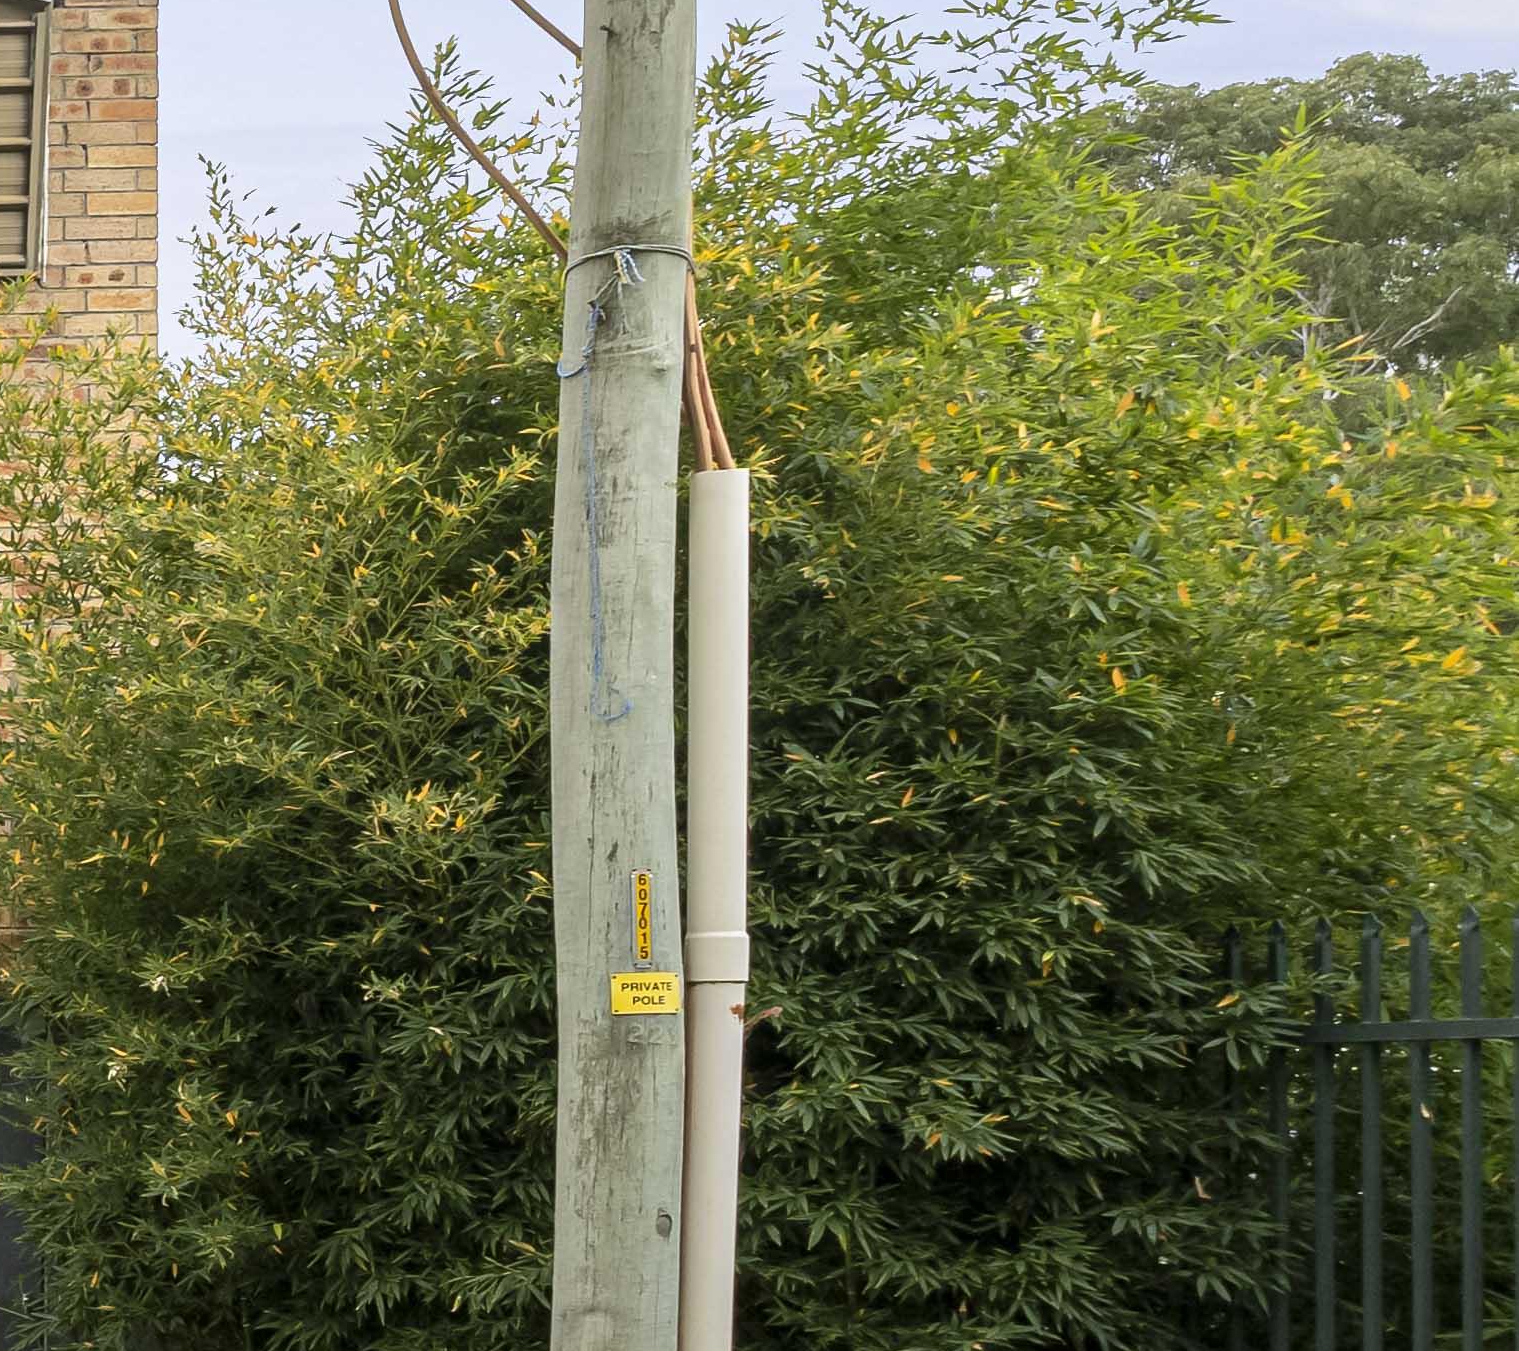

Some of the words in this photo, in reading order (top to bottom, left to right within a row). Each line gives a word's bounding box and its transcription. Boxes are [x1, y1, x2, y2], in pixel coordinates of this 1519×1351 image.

[638, 873, 649, 960] 607015
[621, 981, 673, 992] PRIVATE
[632, 995, 665, 1005] POLE
